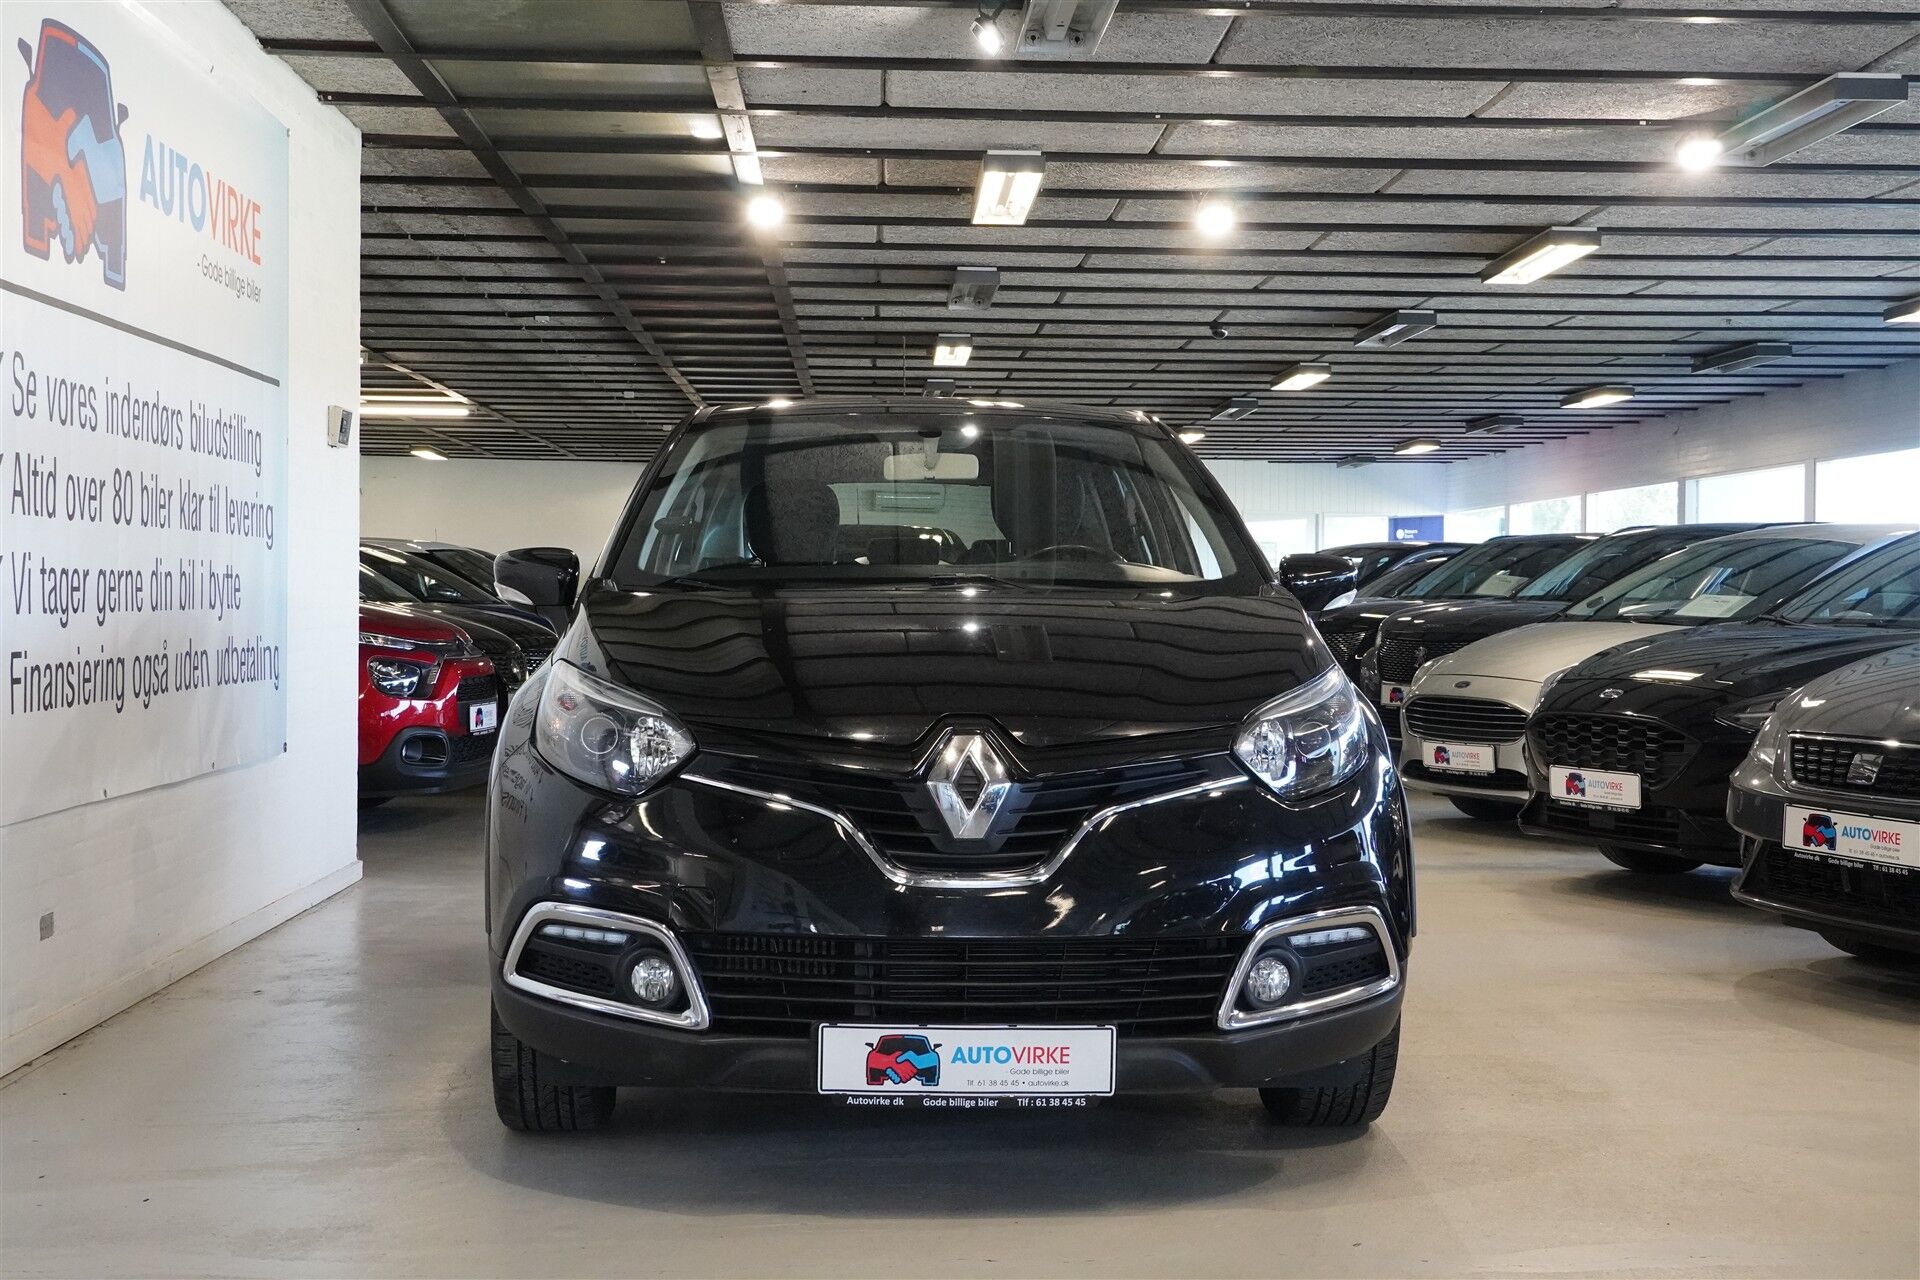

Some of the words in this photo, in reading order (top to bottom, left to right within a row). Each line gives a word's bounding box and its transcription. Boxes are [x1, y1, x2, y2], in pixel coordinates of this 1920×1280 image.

[140, 133, 261, 266] AUTOVIRKE
[202, 254, 222, 284] Gode
[224, 265, 246, 299] billige
[247, 277, 261, 303] biler
[12, 351, 37, 419] Se
[46, 375, 98, 432] vores
[105, 377, 184, 451] indendørs
[190, 400, 262, 478] biludstilling
[11, 451, 57, 519] Altid
[66, 471, 106, 522] over
[113, 467, 133, 526] 80
[141, 471, 173, 530] biler
[179, 478, 204, 532] klar
[209, 483, 220, 534] til
[225, 486, 274, 551] levering
[11, 551, 32, 615] Vi
[40, 557, 89, 628] tager
[96, 567, 144, 627] gerne
[150, 557, 173, 612] din
[179, 558, 195, 611] bil
[200, 560, 204, 610] i
[209, 560, 241, 621] bytte
[10, 645, 125, 715] Finansiering
[132, 640, 169, 710] også
[175, 638, 210, 691] uden
[216, 635, 280, 691] udbetaling
[1588, 780, 1622, 792] AUTOVIRKE
[1842, 826, 1901, 846] AUTOVIRKE
[1840, 859, 1852, 867] billige
[951, 1046, 1070, 1064] AUTOVIRKE
[1032, 1068, 1053, 1076] billige
[846, 1096, 890, 1106] Autovirke
[922, 1098, 947, 1106] Gode
[949, 1098, 976, 1108] billige
[978, 1098, 998, 1106] biler
[1017, 1098, 1028, 1106] Tlf
[1036, 1098, 1046, 1106] 61
[1048, 1098, 1060, 1106] 38
[1062, 1098, 1073, 1106] 45
[1074, 1098, 1086, 1106] 45
